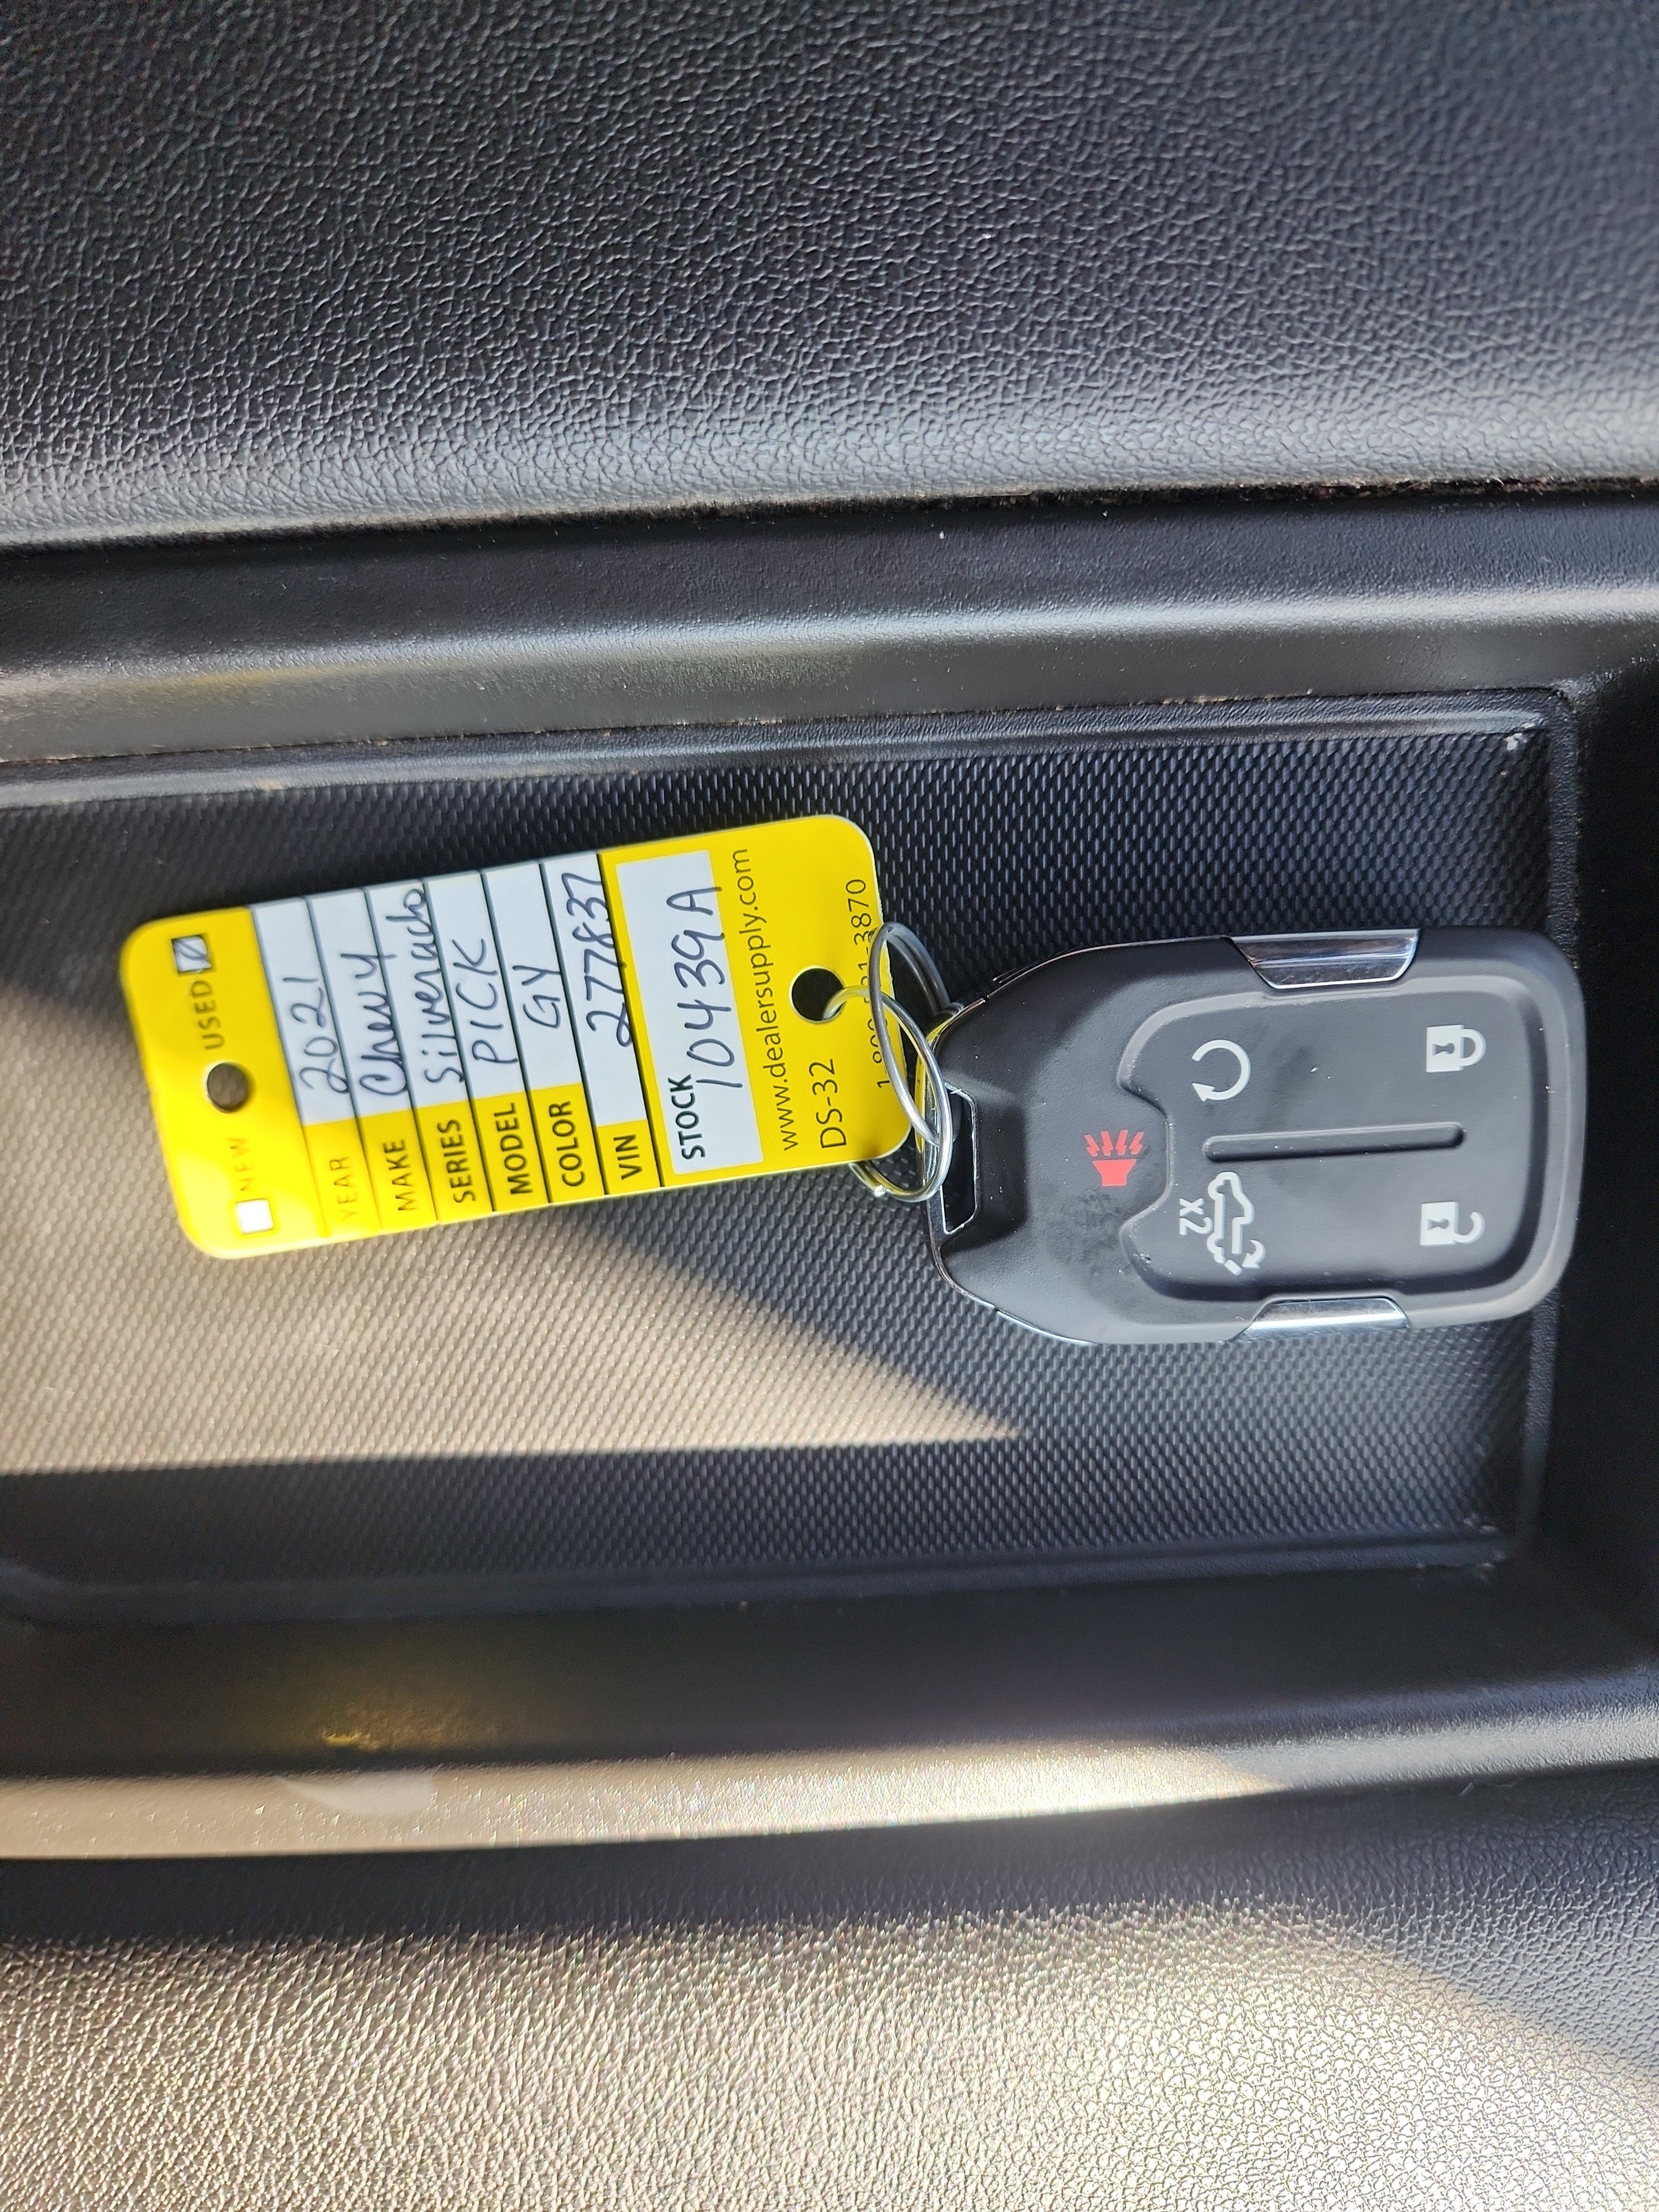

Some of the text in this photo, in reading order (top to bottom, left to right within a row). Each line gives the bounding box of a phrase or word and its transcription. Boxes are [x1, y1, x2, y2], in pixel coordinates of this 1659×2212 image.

[386, 888, 465, 1084] Silverado
[452, 938, 519, 1065] PICK
[513, 964, 561, 1029] GY
[561, 872, 633, 1047] 277837
[666, 886, 743, 1088] 10439A
[732, 848, 799, 1151] www.dealersupply.com
[191, 979, 225, 1050] USED
[283, 977, 350, 1095] 2021
[341, 952, 408, 1097] Chevy
[549, 1100, 586, 1187] COLOR
[667, 1074, 705, 1160] STOCK
[808, 1058, 848, 1150] DS-32
[227, 1136, 255, 1192] NEW
[328, 1155, 359, 1222] YEAR
[383, 1137, 416, 1211] MAKE
[437, 1118, 477, 1202] SERIES
[494, 1102, 534, 1196] MODEL
[613, 1133, 643, 1180] VIN
